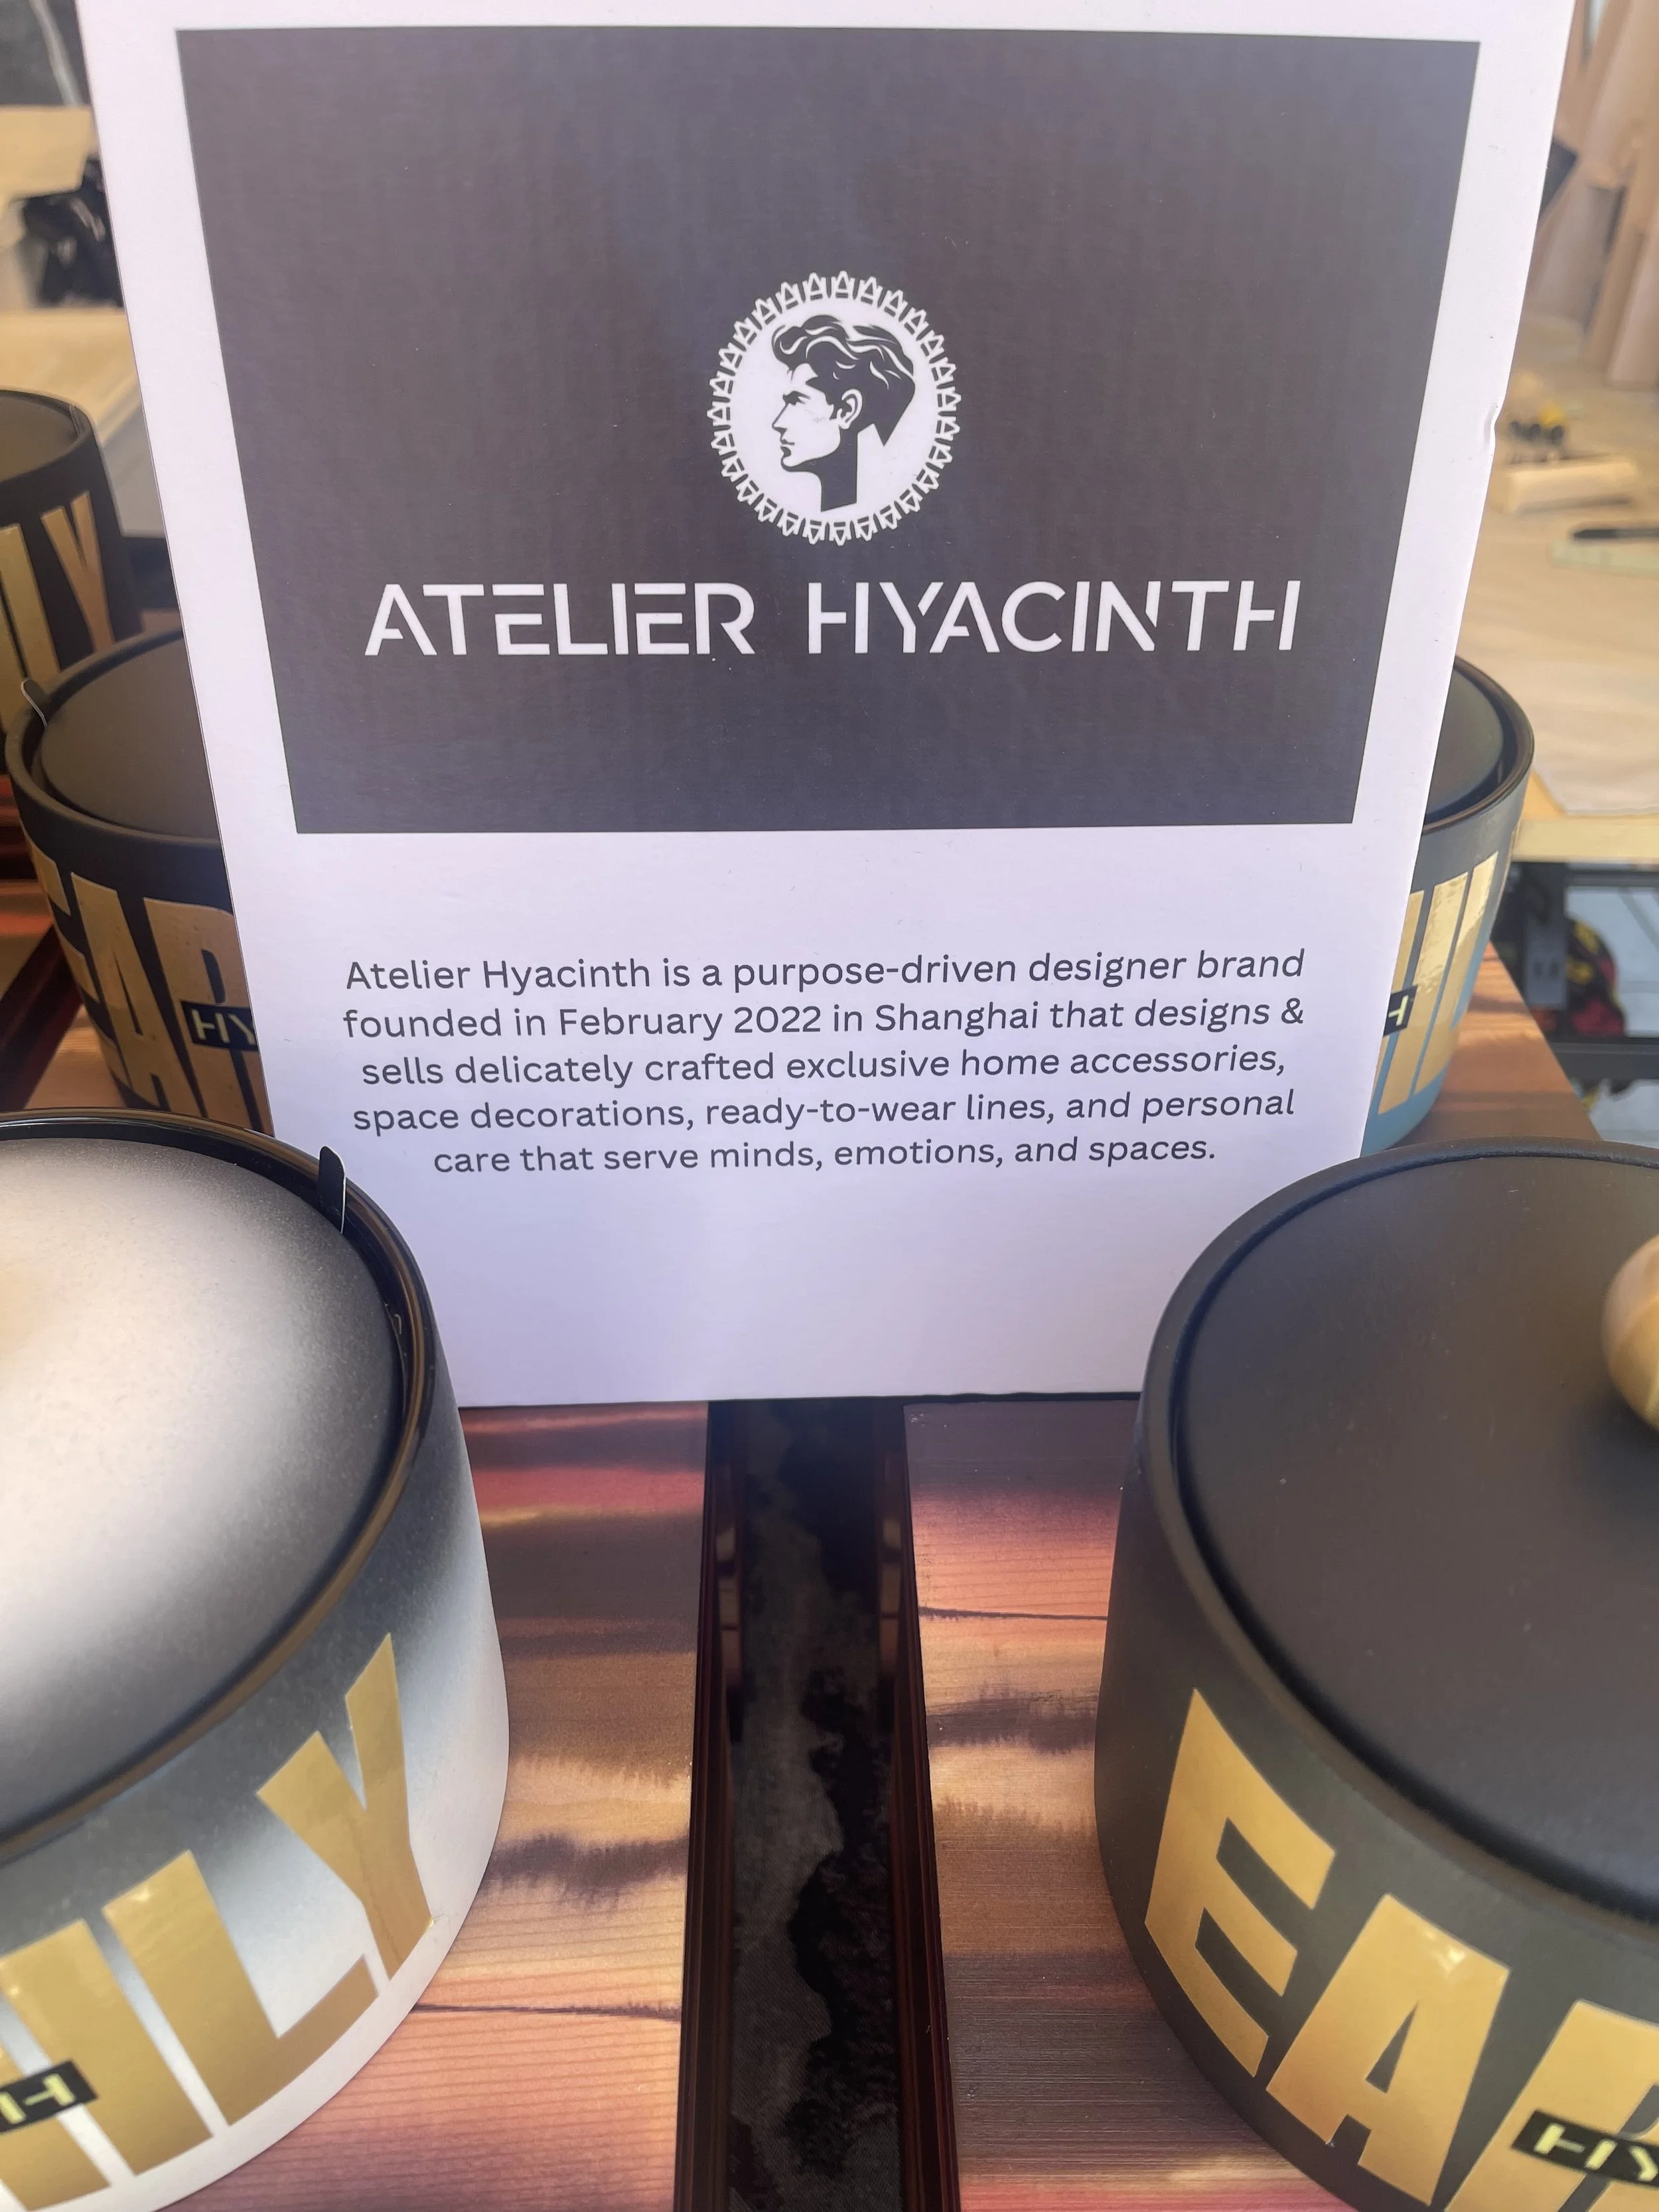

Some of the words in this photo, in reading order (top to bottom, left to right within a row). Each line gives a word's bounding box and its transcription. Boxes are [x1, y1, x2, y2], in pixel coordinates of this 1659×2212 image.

[364, 582, 755, 656] ATELIER
[808, 580, 1301, 654] HYACINTH
[346, 959, 471, 990] Atelier
[482, 958, 650, 996] Hyacinth
[662, 957, 690, 987] is
[702, 964, 723, 987] a
[734, 954, 1016, 994] purpose-driven
[1029, 951, 1187, 988] designer
[1197, 948, 1305, 979] brand
[342, 1007, 502, 1038] founded
[514, 1007, 546, 1037] in
[559, 1006, 723, 1041] February
[734, 1005, 821, 1033] 2022
[833, 1003, 863, 1032] in
[875, 1000, 1039, 1037] Shanghai
[1049, 999, 1124, 1029] that
[1135, 997, 1270, 1033] designs
[1281, 997, 1303, 1024] &
[362, 1057, 444, 1085] sells
[455, 1054, 633, 1089] delicately
[645, 1051, 774, 1081] crafted
[786, 1049, 950, 1079] exclusive
[962, 1049, 1059, 1076] home
[1070, 1044, 1285, 1076] accessories,
[353, 1109, 459, 1138] space
[470, 1099, 693, 1131] decorations,
[707, 1096, 956, 1131] ready-to-wear
[967, 1094, 1054, 1125] lines,
[1066, 1090, 1131, 1119] and
[1142, 1088, 1294, 1124] personal
[434, 1153, 510, 1173] care
[519, 1145, 595, 1171] that
[604, 1149, 698, 1170] serve
[711, 1140, 822, 1172] minds,
[834, 1138, 1003, 1169] emotions,
[1015, 1136, 1078, 1163] and
[1088, 1140, 1215, 1167] spaces.
